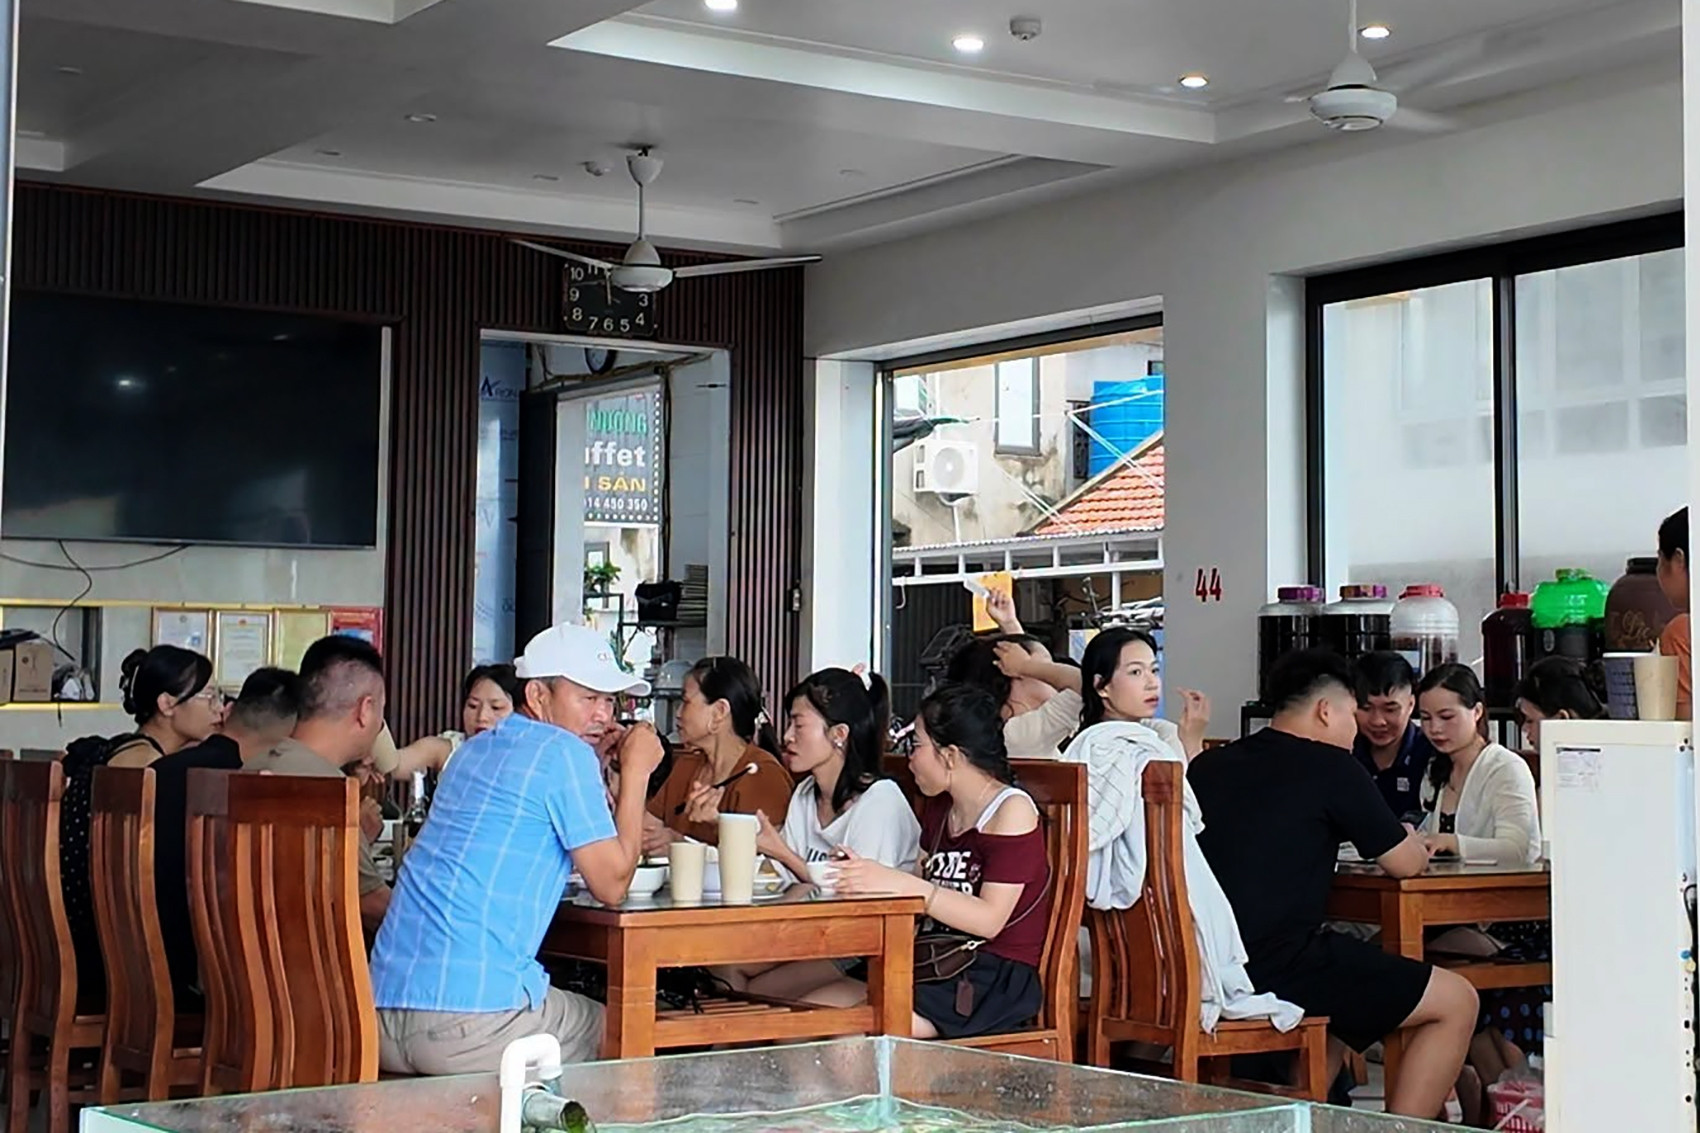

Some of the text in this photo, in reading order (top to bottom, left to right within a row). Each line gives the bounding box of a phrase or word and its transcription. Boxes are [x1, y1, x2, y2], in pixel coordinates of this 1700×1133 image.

[570, 267, 584, 281] 10
[569, 287, 580, 302] 9
[639, 293, 649, 307] 3
[572, 307, 583, 321] 8
[635, 312, 645, 326] 4
[588, 316, 599, 330] 7
[603, 317, 614, 331] 6
[620, 318, 630, 332] 5
[603, 497, 624, 510] 450
[627, 498, 648, 511] 350
[1195, 568, 1222, 603] 44
